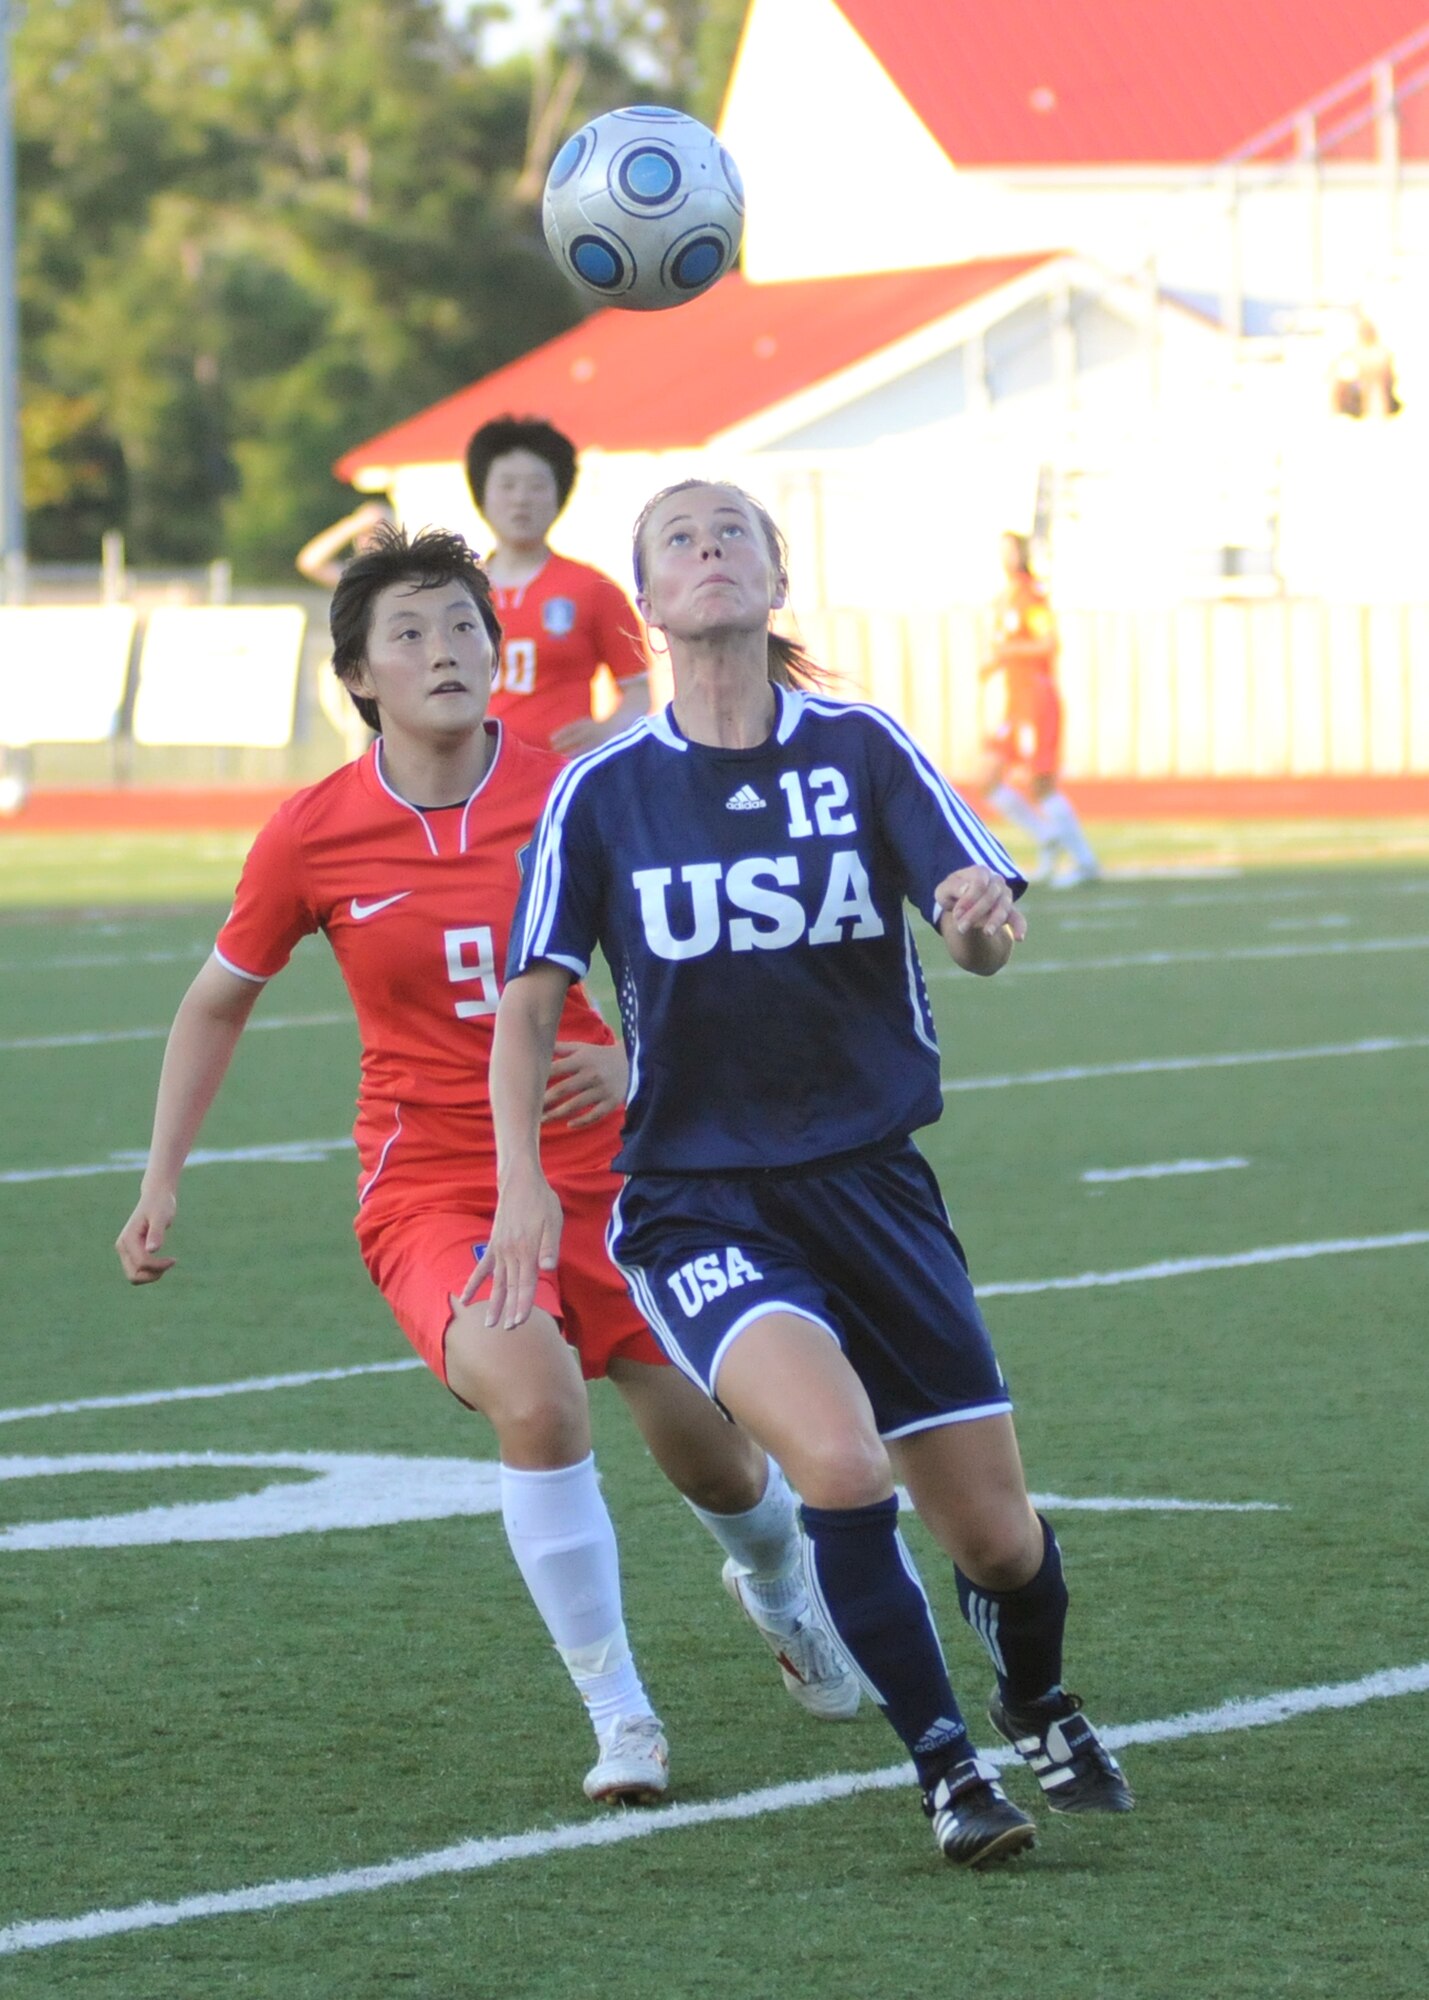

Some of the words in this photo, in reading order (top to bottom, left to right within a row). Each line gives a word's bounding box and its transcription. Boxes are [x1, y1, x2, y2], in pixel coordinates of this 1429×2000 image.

[725, 799, 767, 810] adidas
[779, 767, 857, 838] 12
[632, 850, 885, 961] USA
[444, 926, 501, 1019] 9
[667, 1246, 764, 1318] USA
[914, 1722, 966, 1753] adidas
